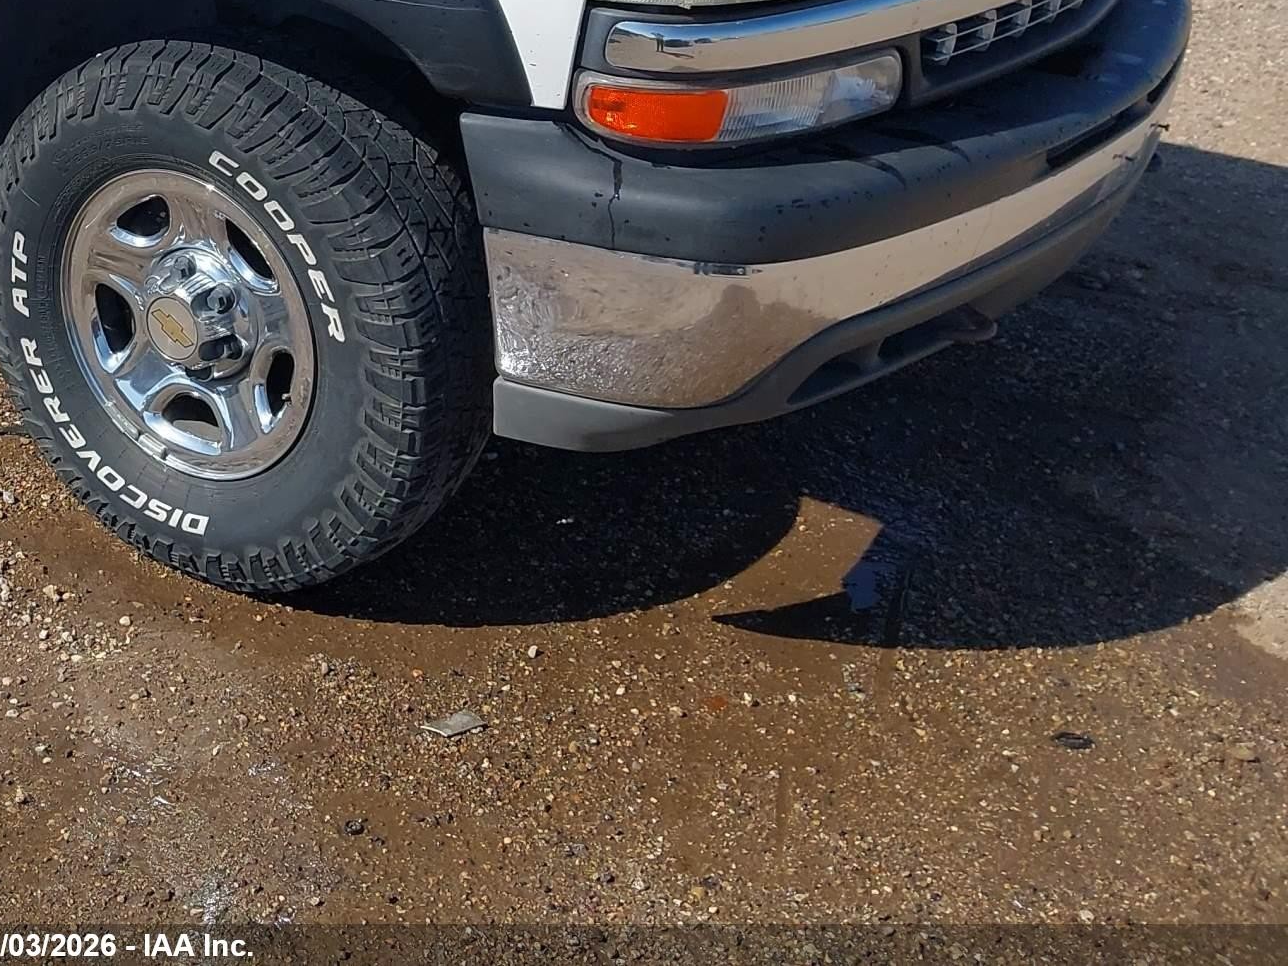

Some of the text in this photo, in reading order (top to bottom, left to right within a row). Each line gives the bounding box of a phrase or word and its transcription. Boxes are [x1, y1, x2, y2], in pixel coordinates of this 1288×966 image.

[11, 230, 30, 318] ATP
[208, 150, 345, 343] COOPER
[20, 337, 210, 536] DISCOVERER
